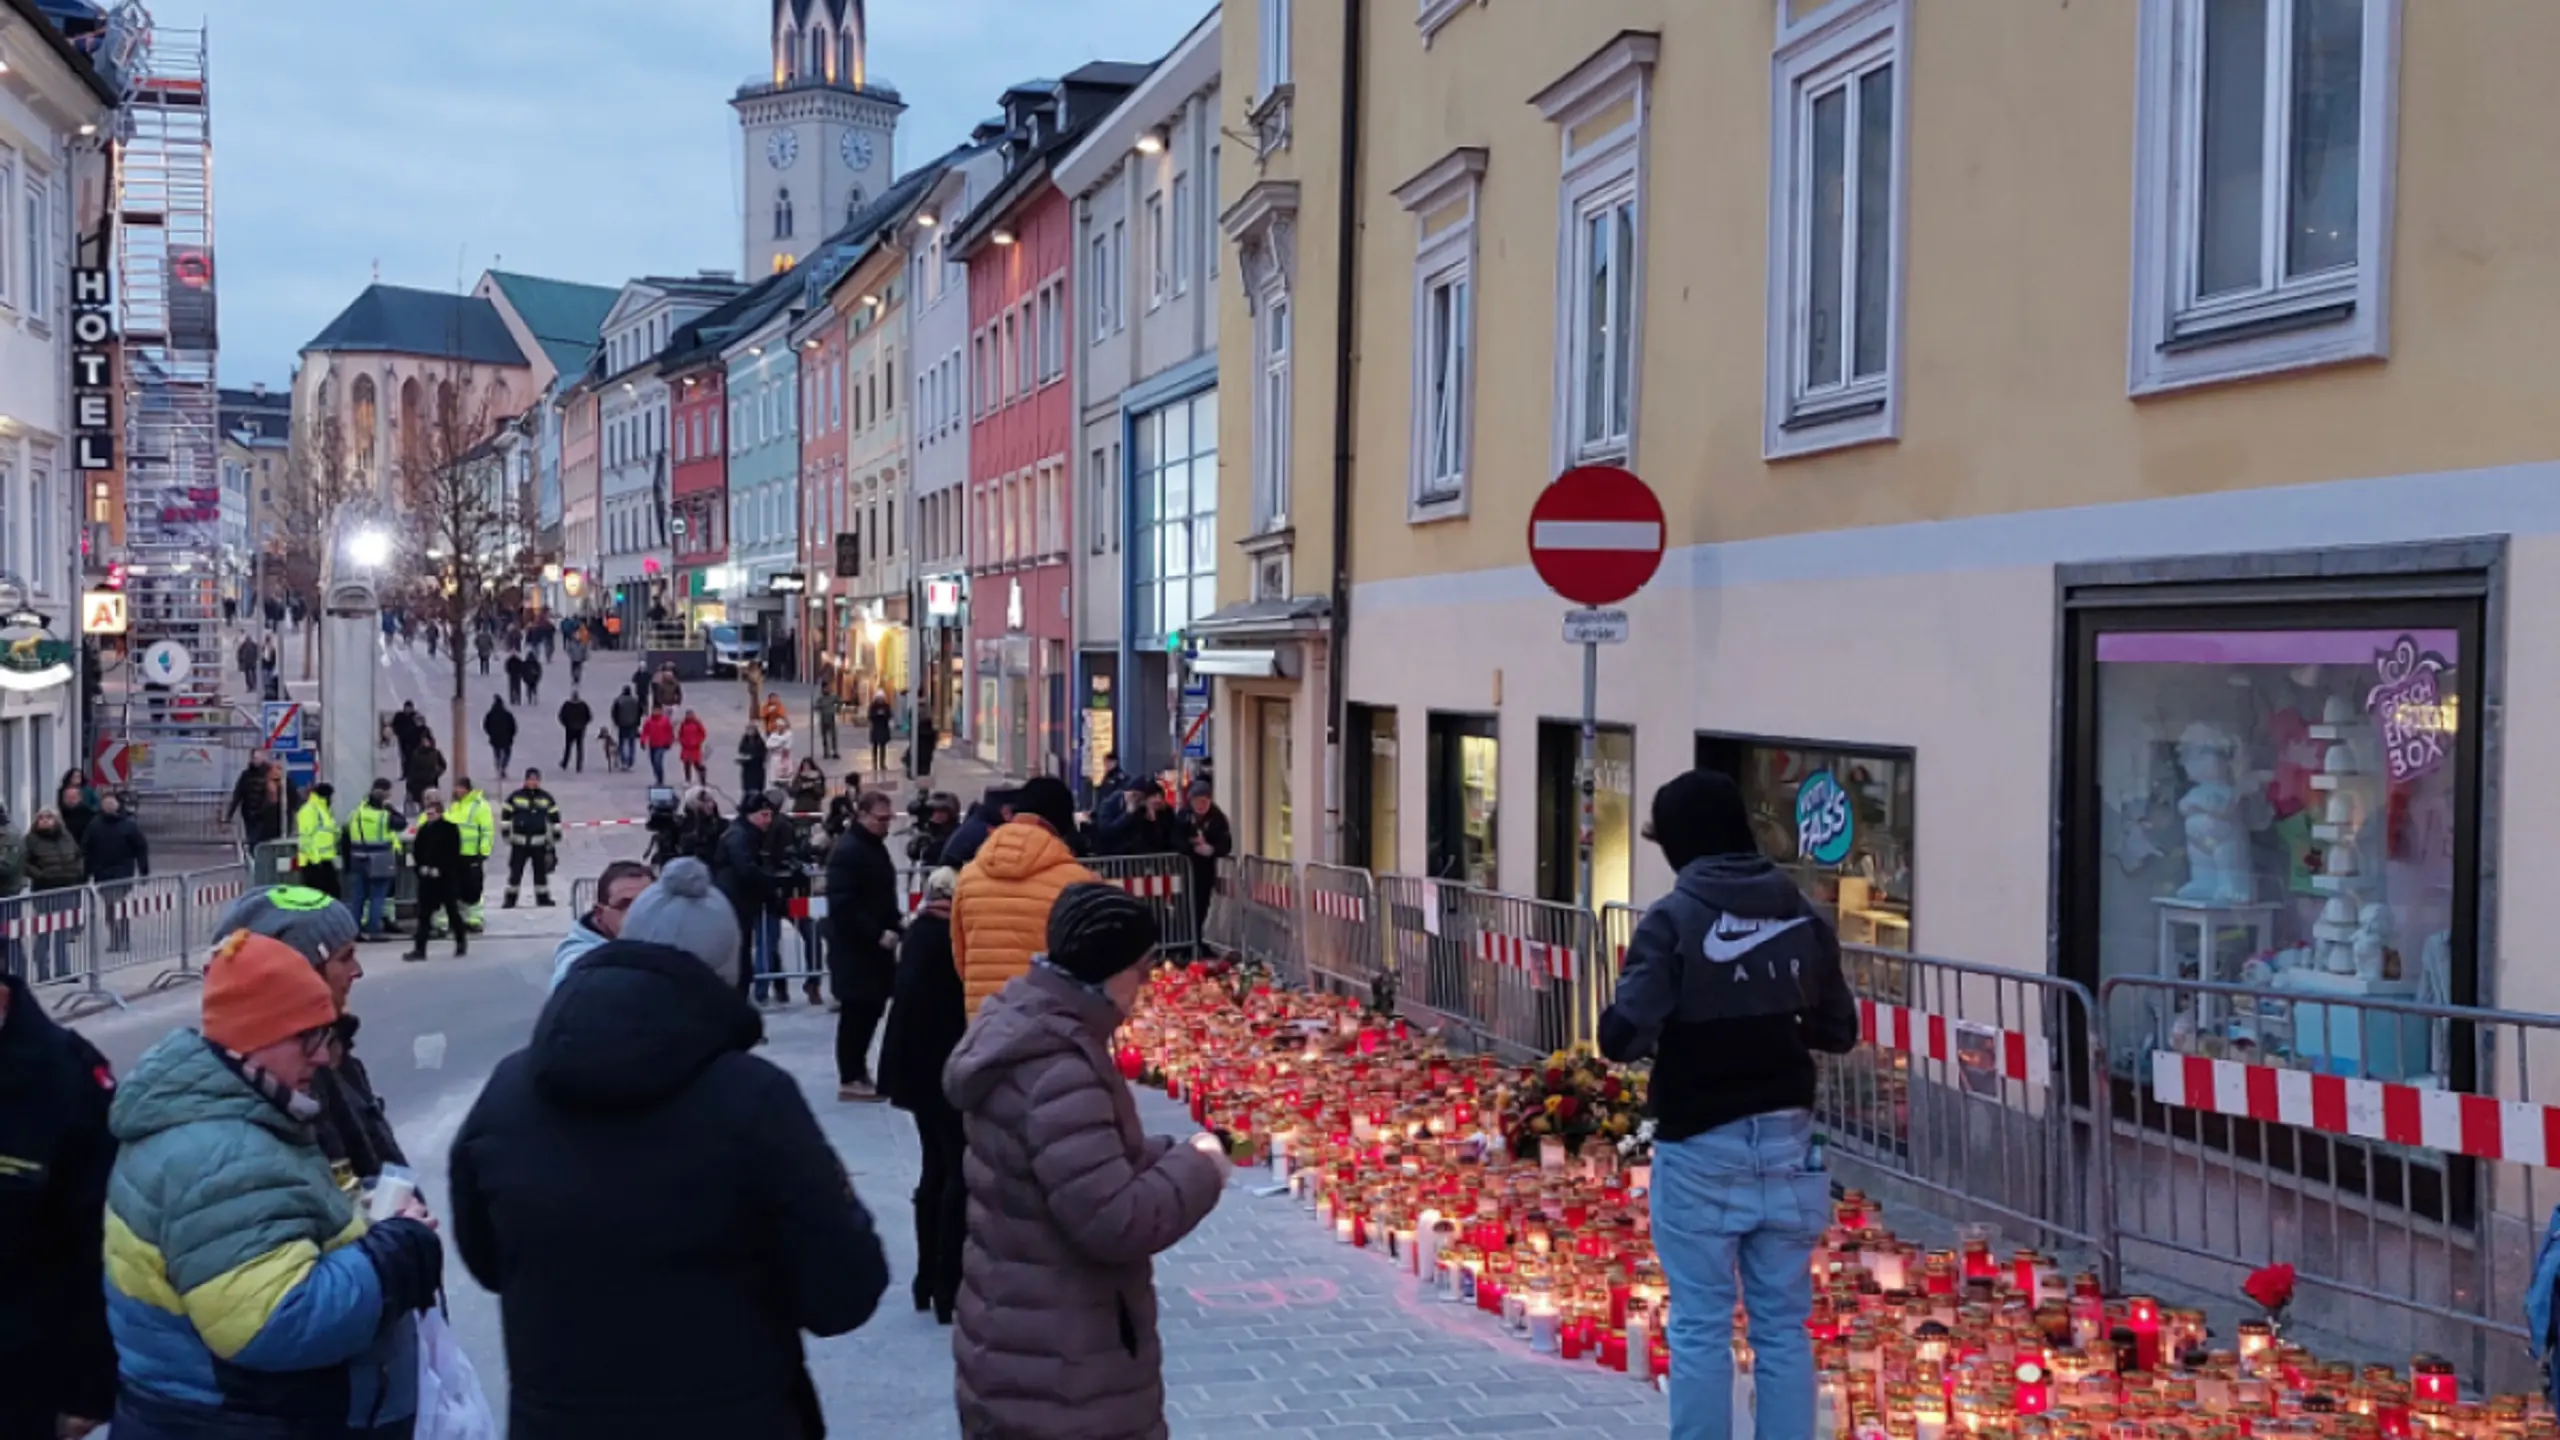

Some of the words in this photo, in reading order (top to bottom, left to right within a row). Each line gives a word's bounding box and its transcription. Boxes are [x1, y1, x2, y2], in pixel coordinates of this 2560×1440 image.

[76, 271, 108, 469] HOTEL
[91, 598, 121, 628] A1
[2388, 731, 2444, 777] BOX
[1798, 790, 1845, 858] FASS
[1733, 958, 1800, 983] AIR
